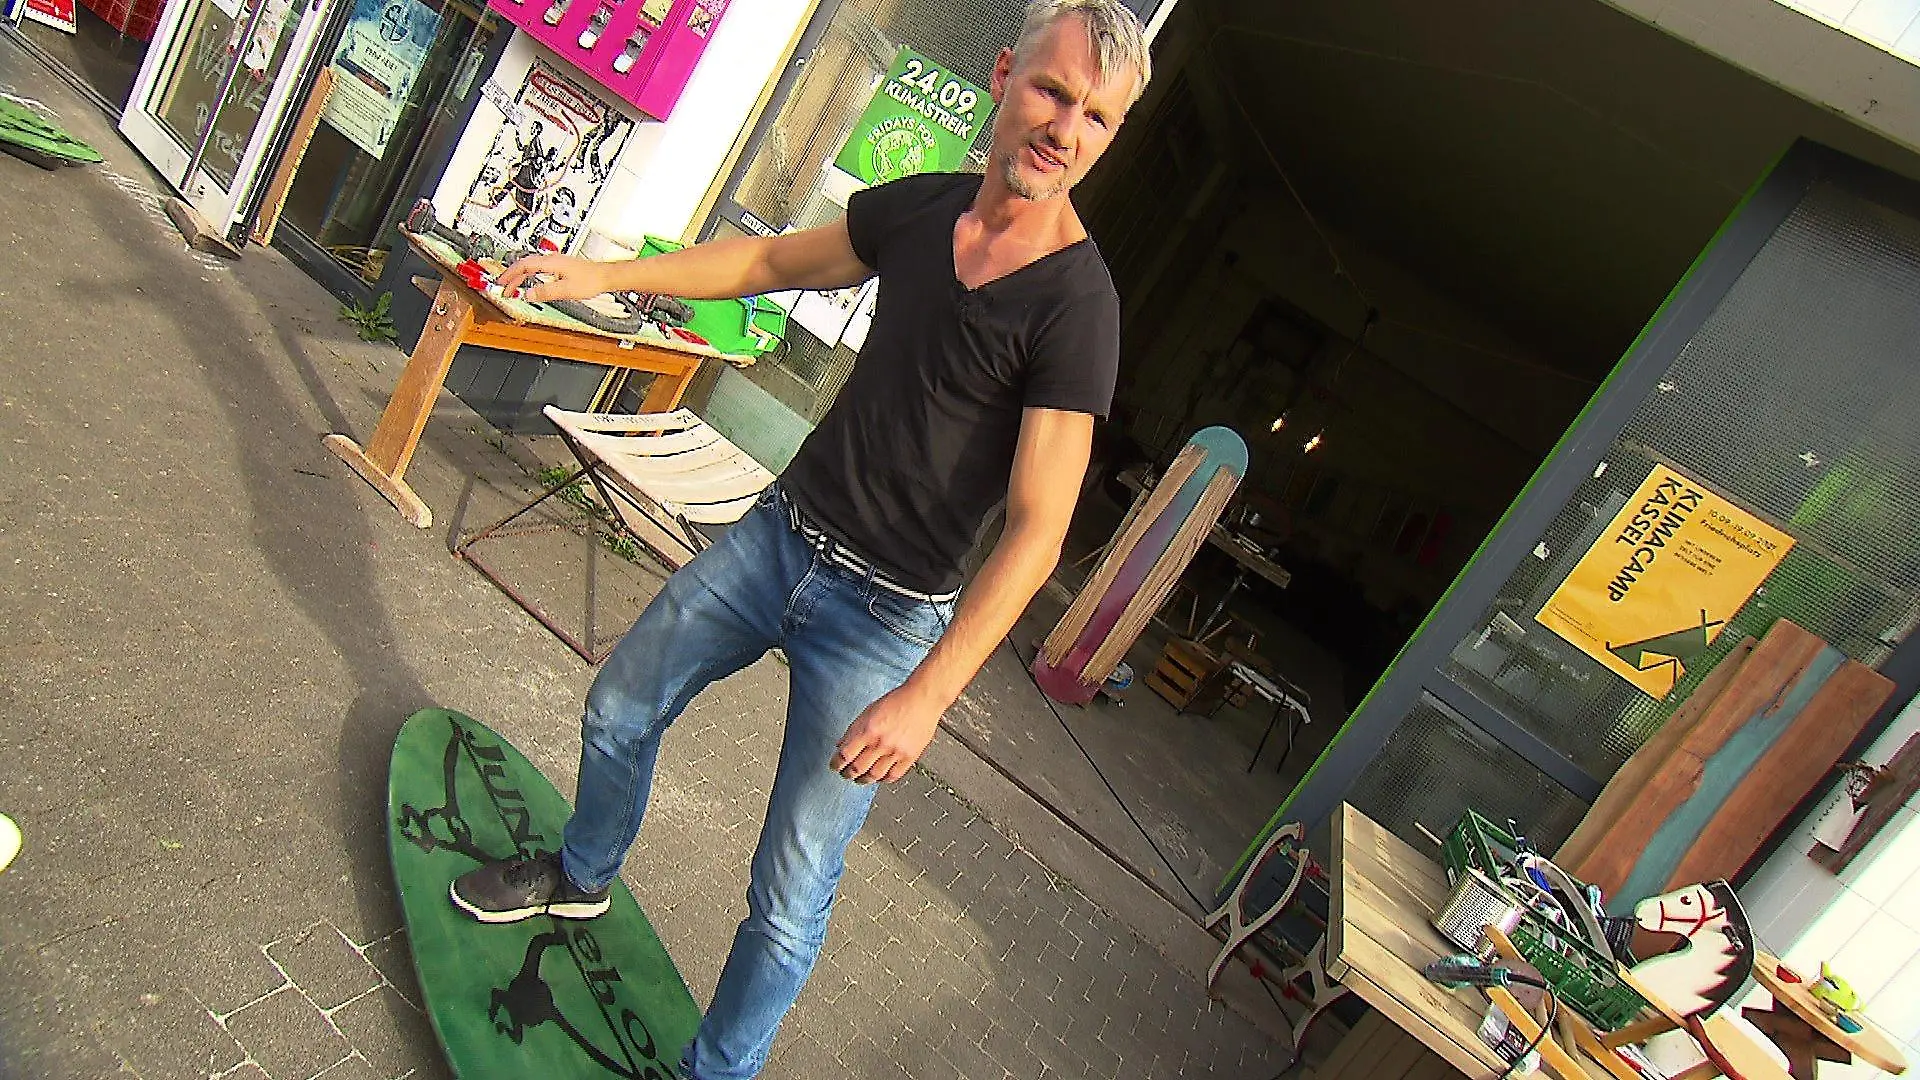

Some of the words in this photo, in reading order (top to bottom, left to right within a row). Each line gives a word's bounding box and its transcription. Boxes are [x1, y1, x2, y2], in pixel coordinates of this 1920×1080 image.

[884, 79, 973, 140] KLIMASTREIK
[899, 59, 978, 122] 24.09.
[866, 116, 916, 145] FRIDAYS
[916, 122, 936, 149] FOR
[1615, 476, 1683, 546] KASSEL
[1700, 519, 1761, 558] Friedrichsplatz
[1607, 488, 1703, 602] KLIMACAMP
